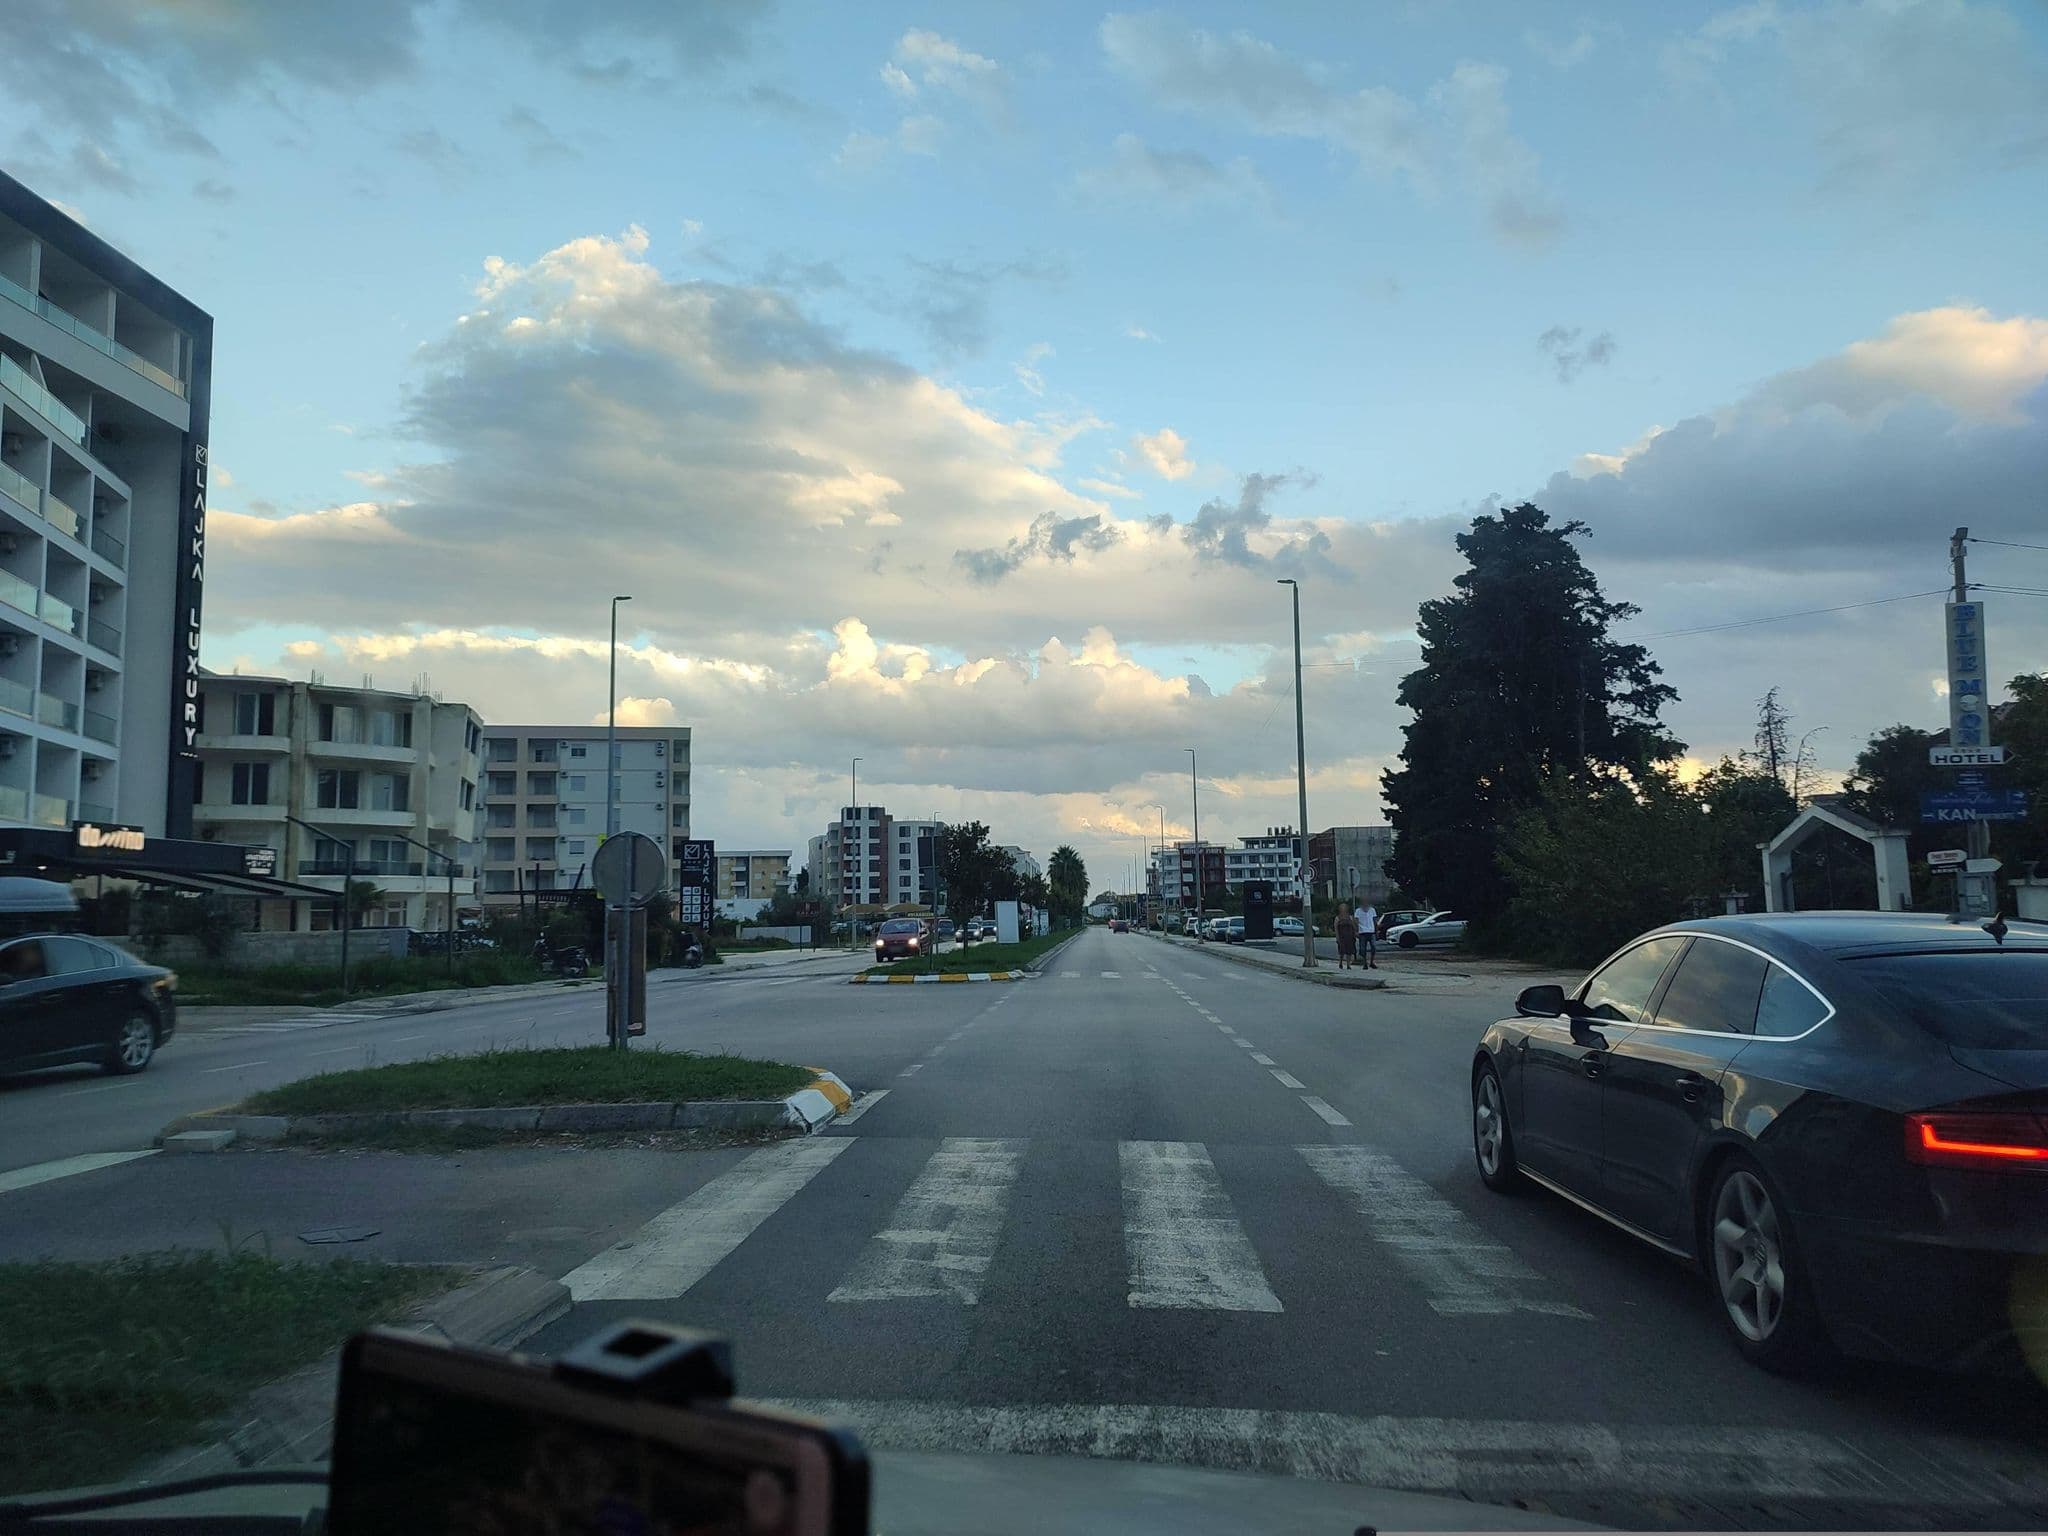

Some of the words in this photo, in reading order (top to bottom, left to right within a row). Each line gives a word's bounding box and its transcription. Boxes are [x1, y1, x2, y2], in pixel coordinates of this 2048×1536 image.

[191, 468, 205, 582] LAJKA
[1953, 604, 1978, 673] BLUE
[184, 607, 200, 746] LUXURY
[1934, 753, 2000, 764] HOTEL
[1937, 808, 1977, 821] KAN
[702, 844, 710, 883] LAJKA
